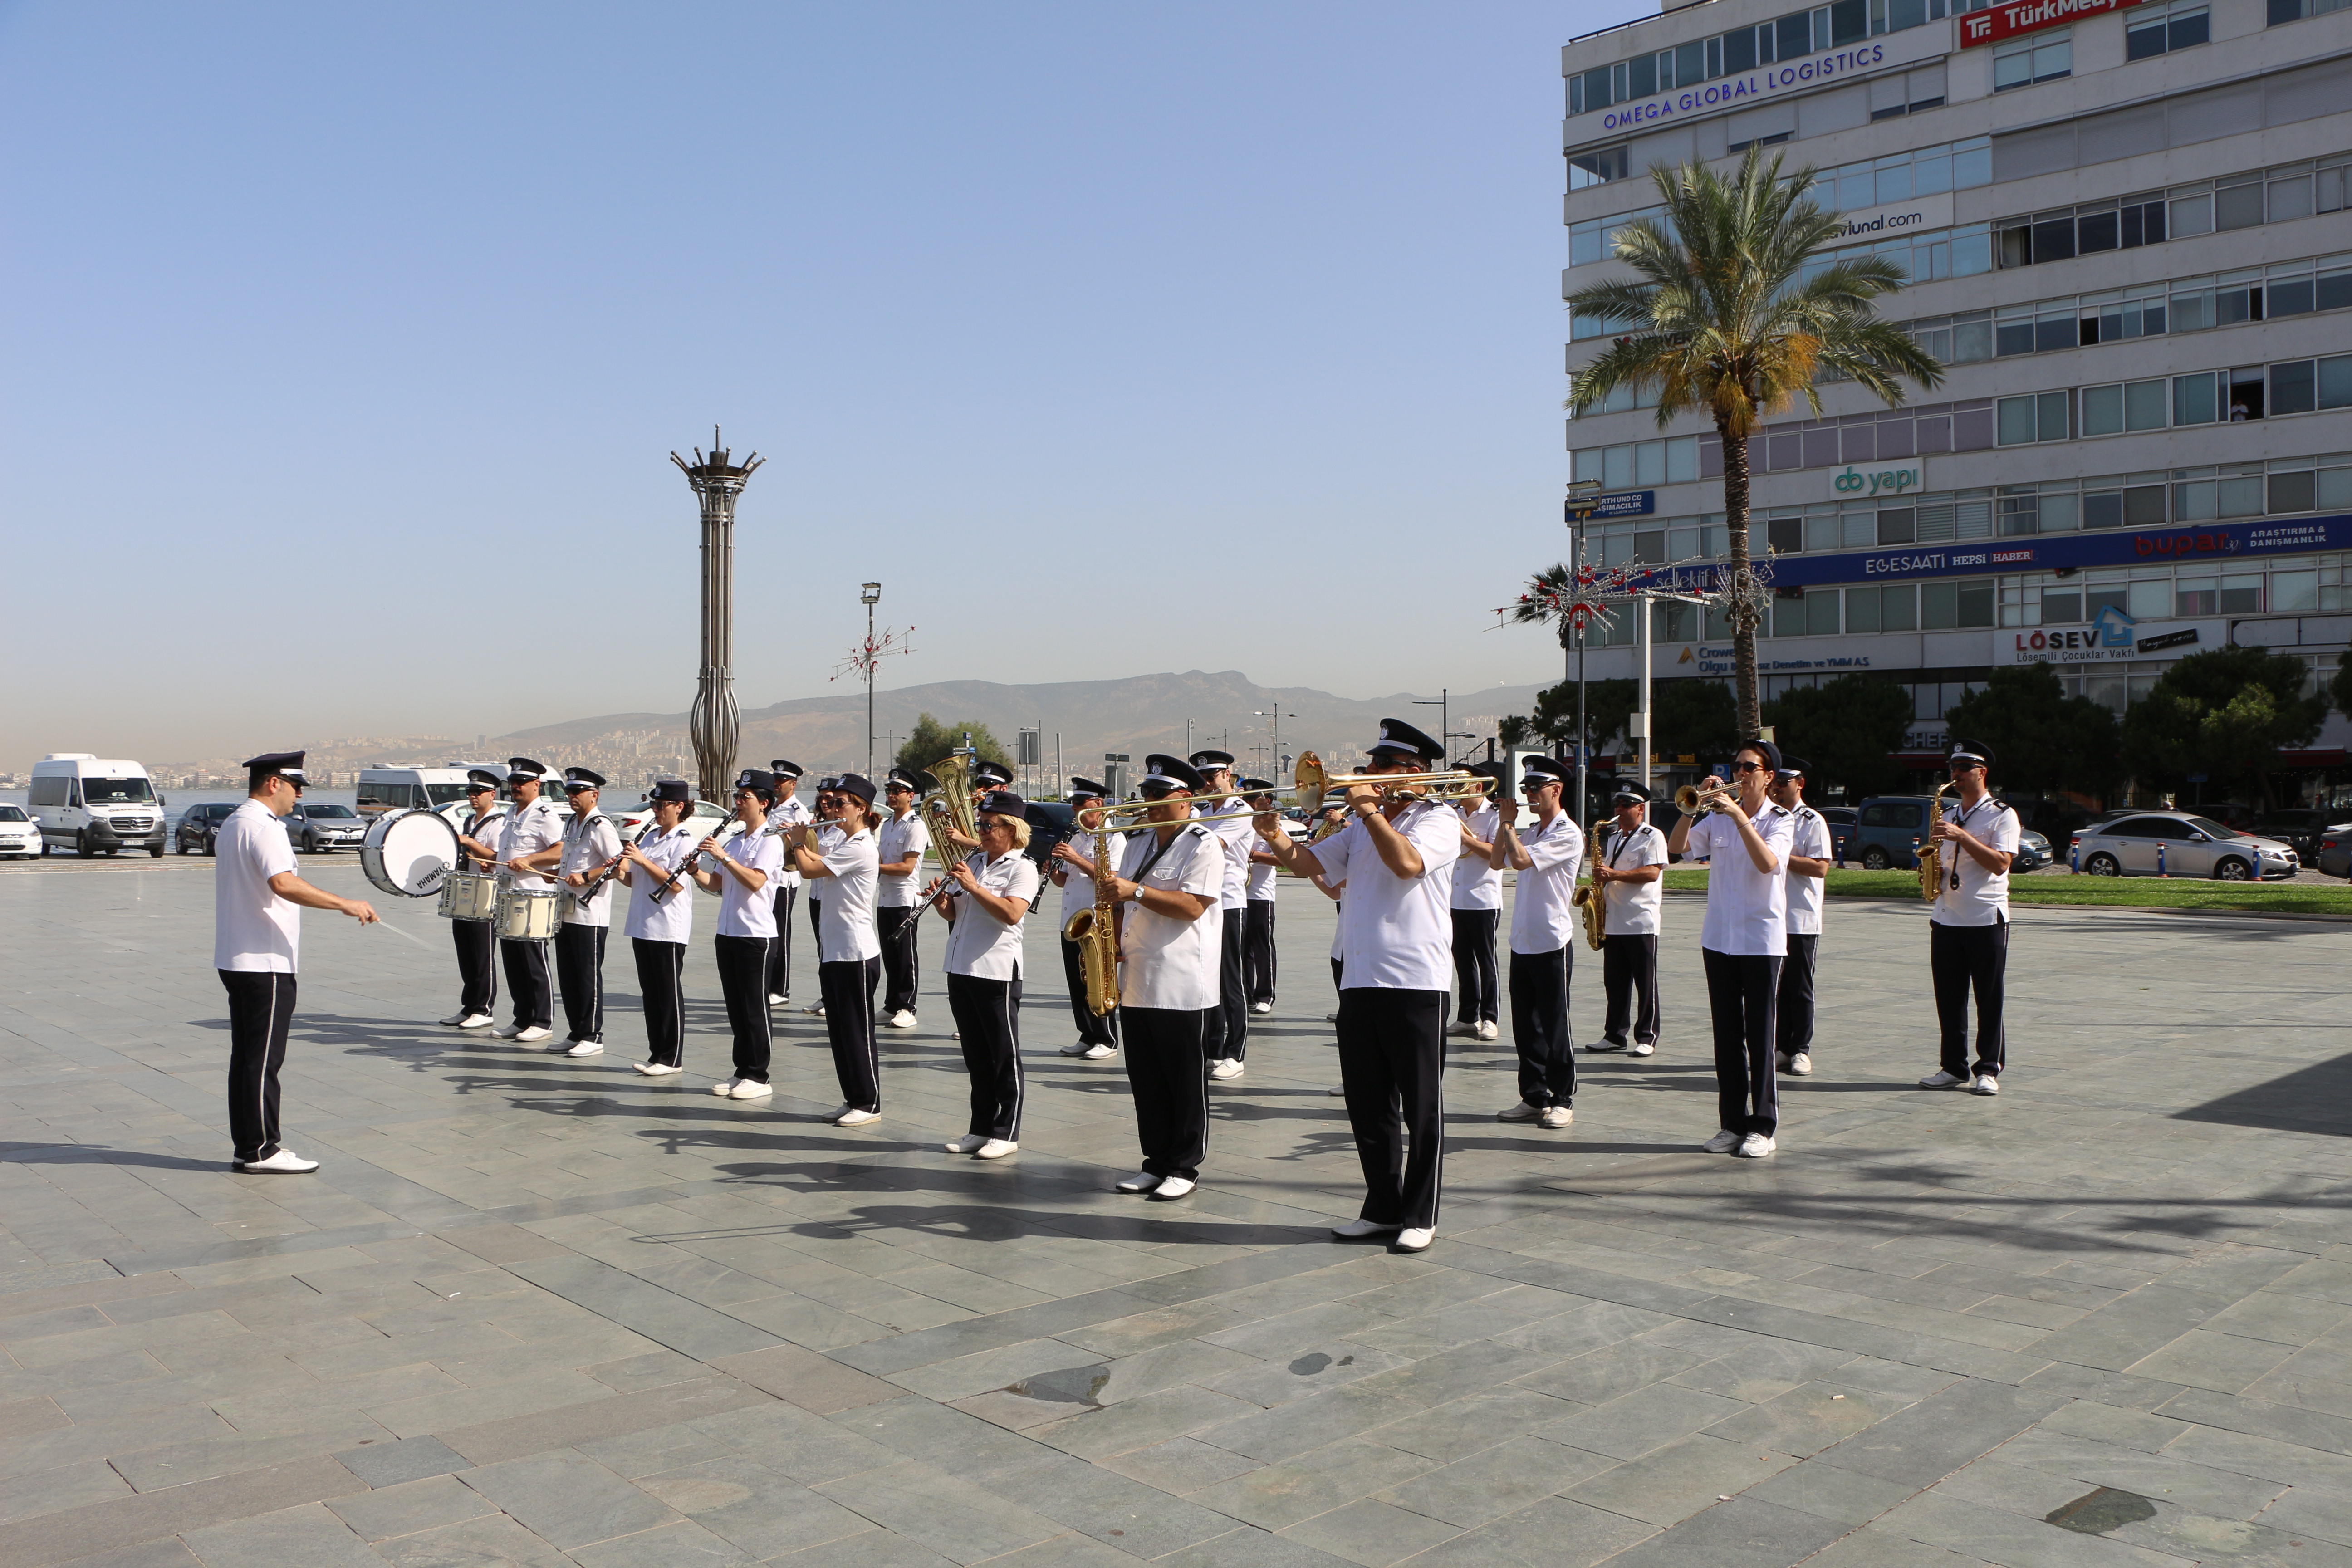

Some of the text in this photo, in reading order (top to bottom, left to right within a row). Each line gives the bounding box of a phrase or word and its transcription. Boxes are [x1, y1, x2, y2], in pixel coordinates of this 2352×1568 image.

[2005, 0, 2117, 29] TürkMe
[1604, 44, 1884, 130] OMEGA GLOBAL LOGISTICS
[2250, 534, 2326, 547] DANIŞMANLIK
[2251, 528, 2314, 538] ARAŞTIRMA
[2135, 533, 2229, 556] bupar
[1993, 551, 2031, 562] HABER
[2016, 630, 2098, 651] LÖSEV
[2017, 649, 2134, 662] Lösemili Çocuklar Vakfı
[1698, 660, 1728, 675] Olgu
[1772, 660, 1812, 669] Denetim
[1827, 657, 1852, 666] YMM
[416, 866, 443, 889] YAMAHA
